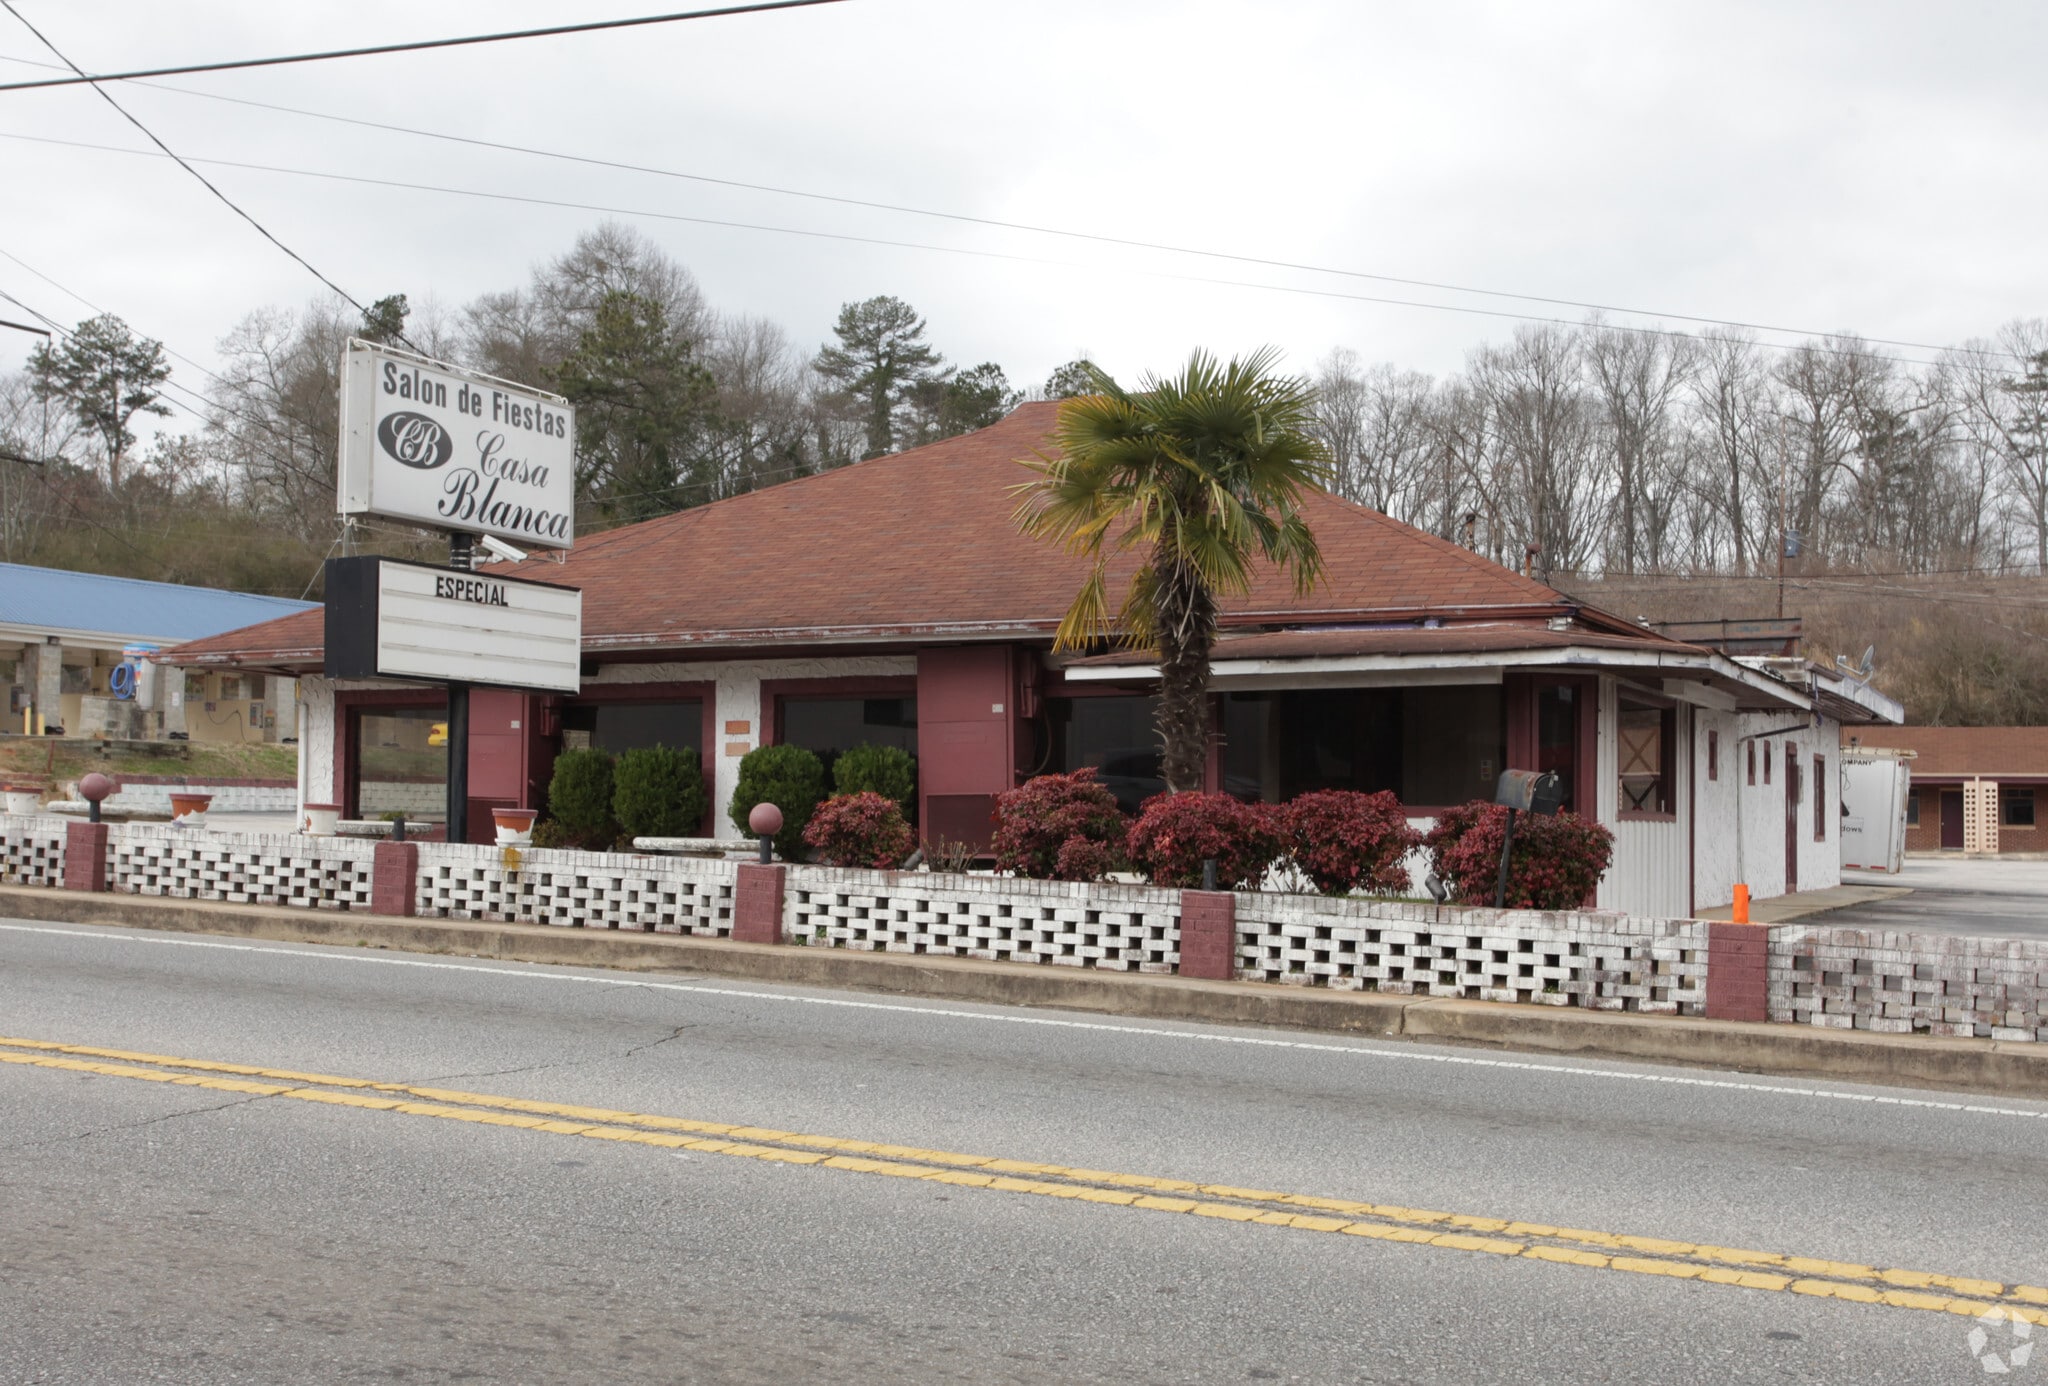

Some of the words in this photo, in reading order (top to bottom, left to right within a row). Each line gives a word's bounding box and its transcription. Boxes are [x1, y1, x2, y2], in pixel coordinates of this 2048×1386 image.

[383, 361, 447, 408] Salon
[458, 383, 482, 417] de
[493, 391, 565, 439] Fiestas
[476, 430, 549, 488] Casa
[438, 467, 569, 539] Blanca
[435, 576, 509, 607] ESPECIAL
